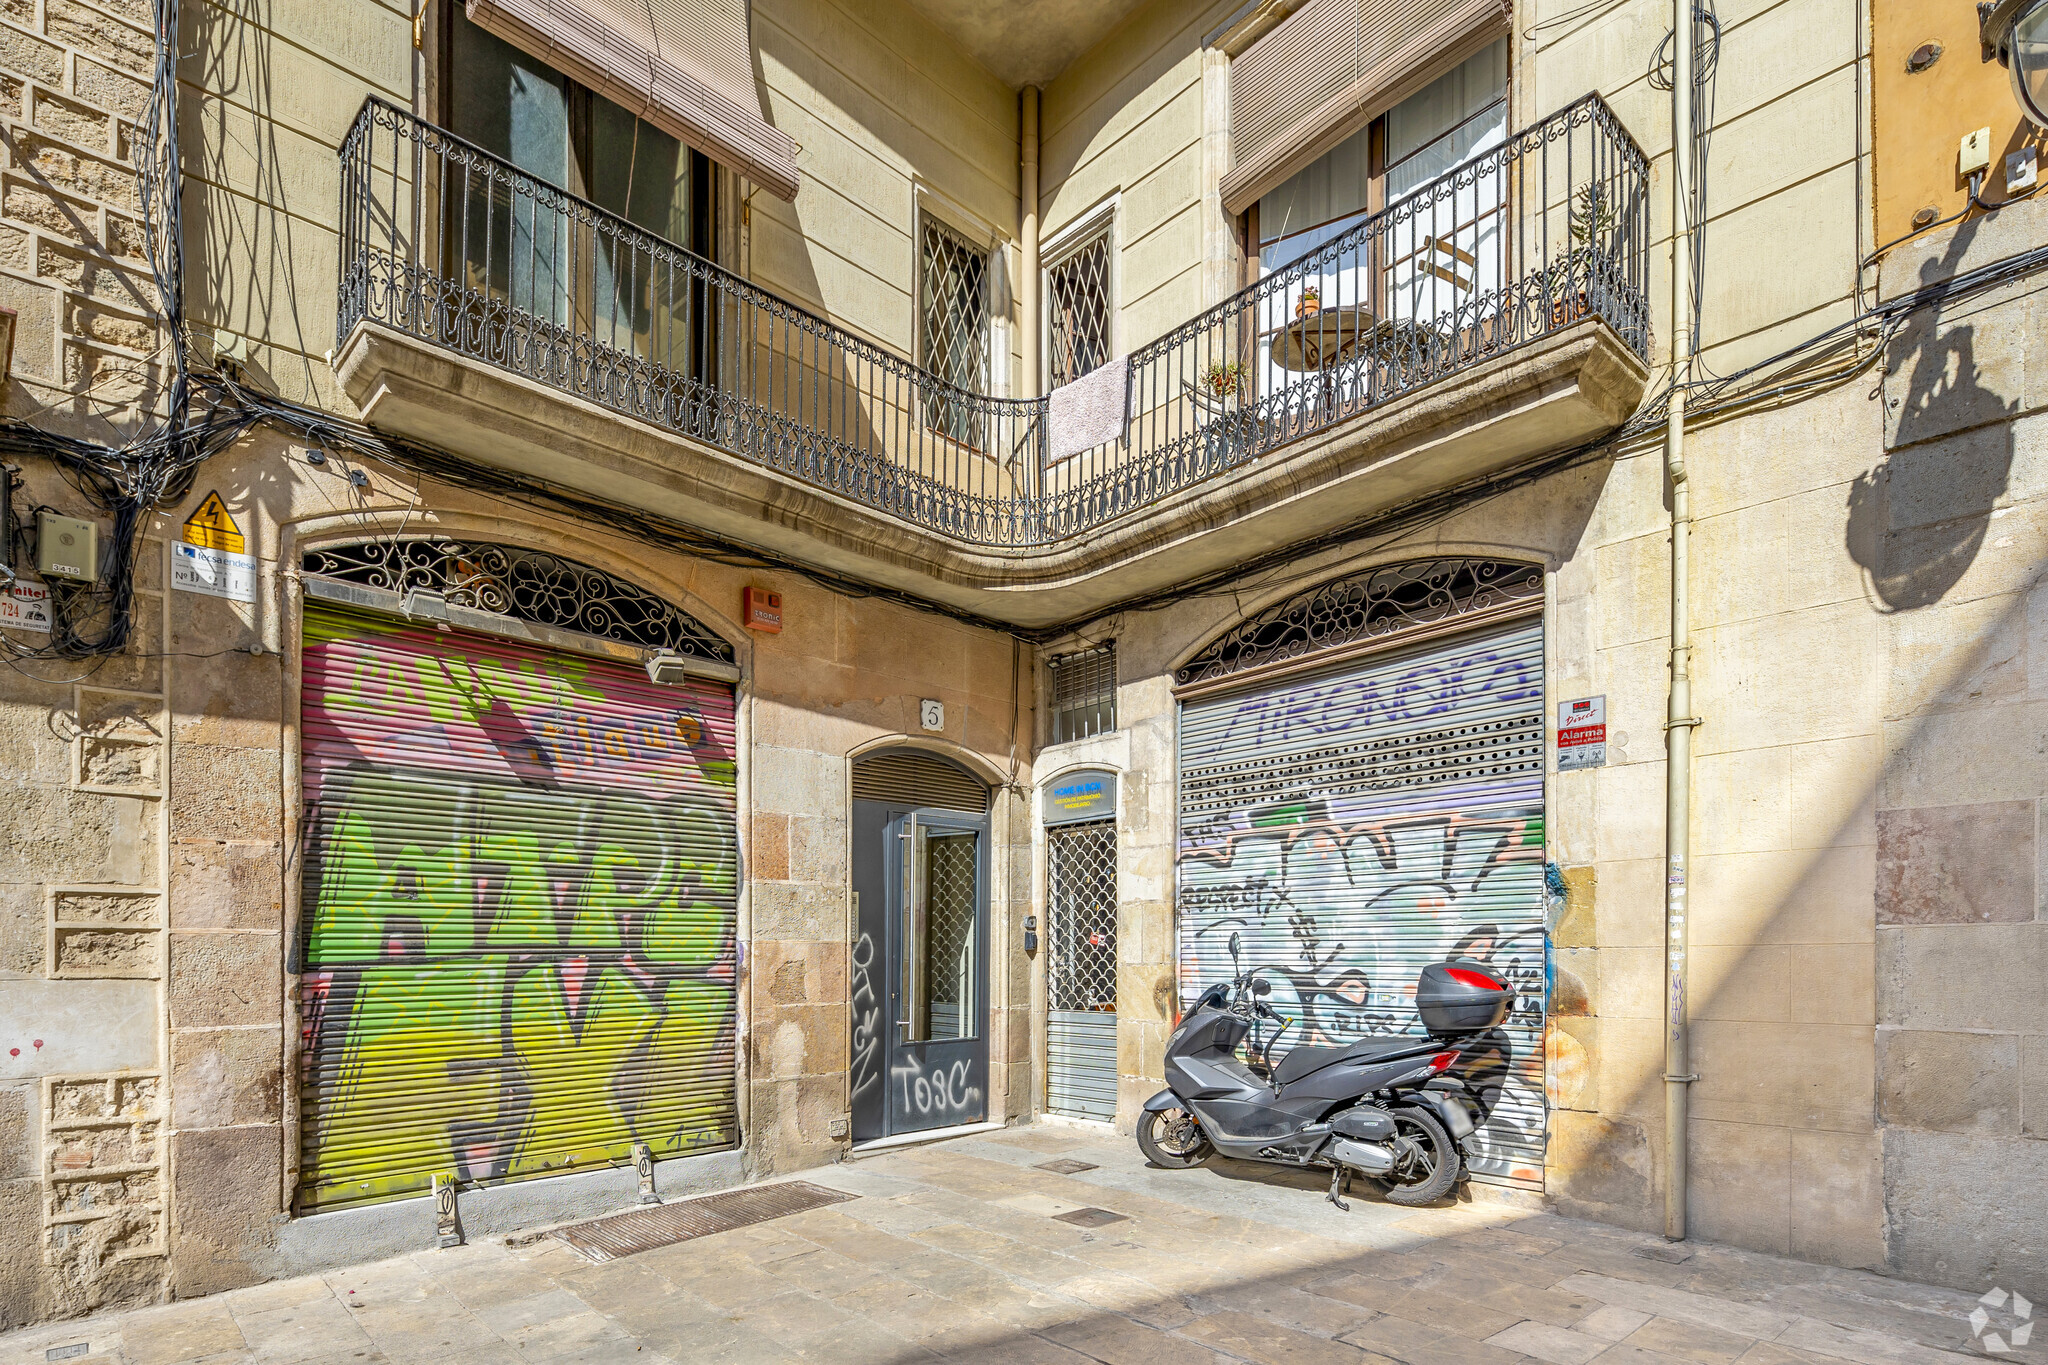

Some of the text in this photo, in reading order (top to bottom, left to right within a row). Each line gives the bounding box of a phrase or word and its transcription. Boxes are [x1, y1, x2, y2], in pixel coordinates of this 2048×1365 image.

[53, 564, 79, 574] 3415
[223, 557, 256, 571] endesa
[928, 706, 939, 725] 5
[1560, 728, 1604, 741] Alarma
[1054, 781, 1101, 796] HOME IN BCN
